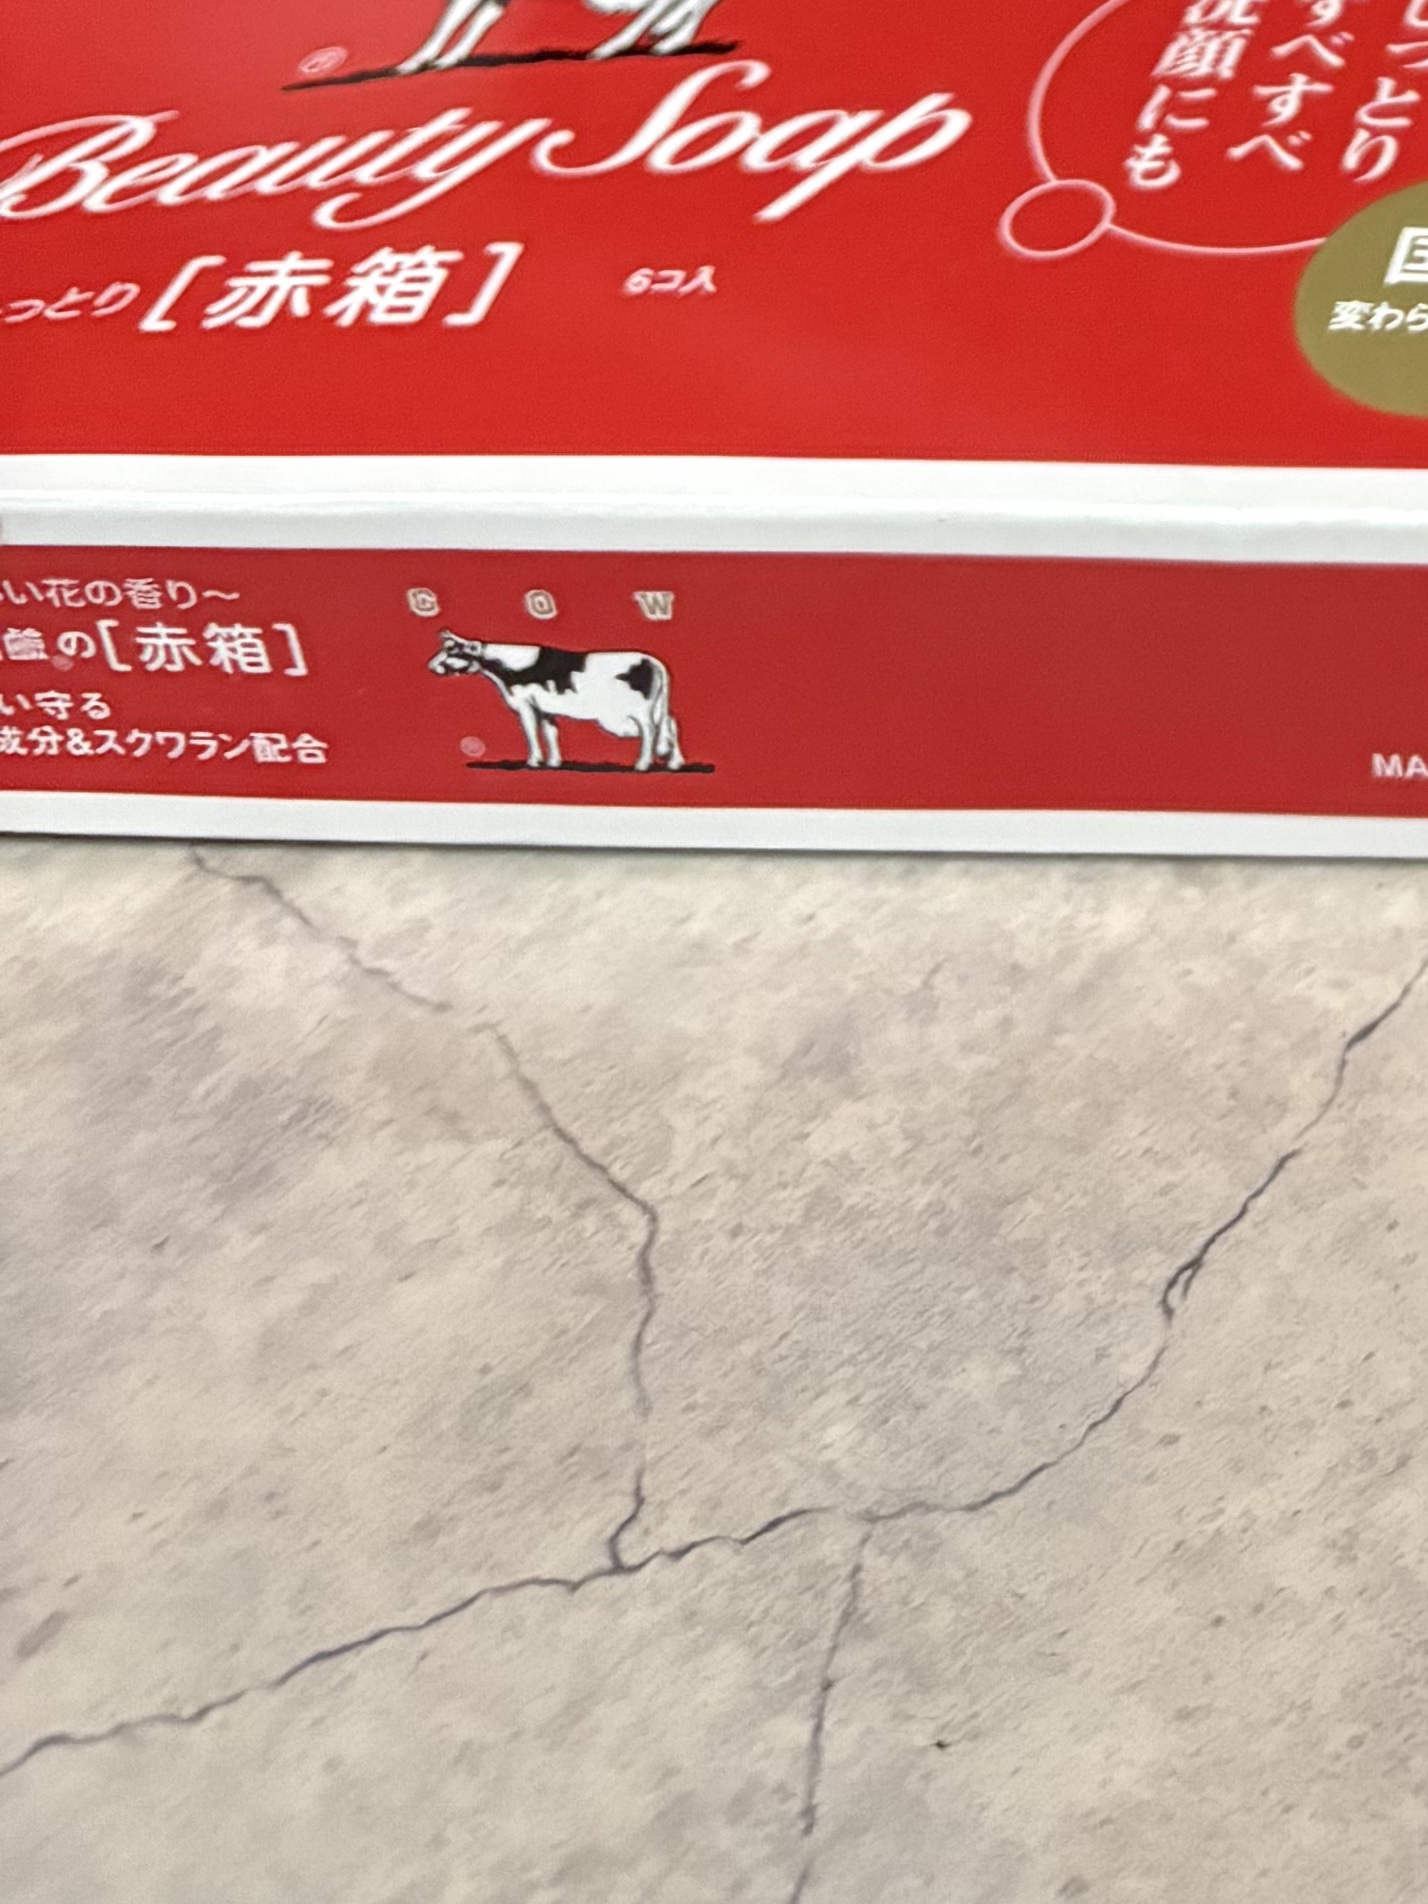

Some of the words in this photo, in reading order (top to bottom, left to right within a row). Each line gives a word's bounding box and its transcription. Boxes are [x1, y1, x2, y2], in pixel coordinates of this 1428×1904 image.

[0, 110, 552, 229] Beauty
[532, 60, 973, 222] Soap
[622, 266, 718, 297] 6コ入
[0, 282, 141, 324] っとり
[0, 577, 241, 611] い花の香り〜
[408, 586, 440, 617] C
[526, 589, 558, 620] O
[634, 590, 674, 621] W
